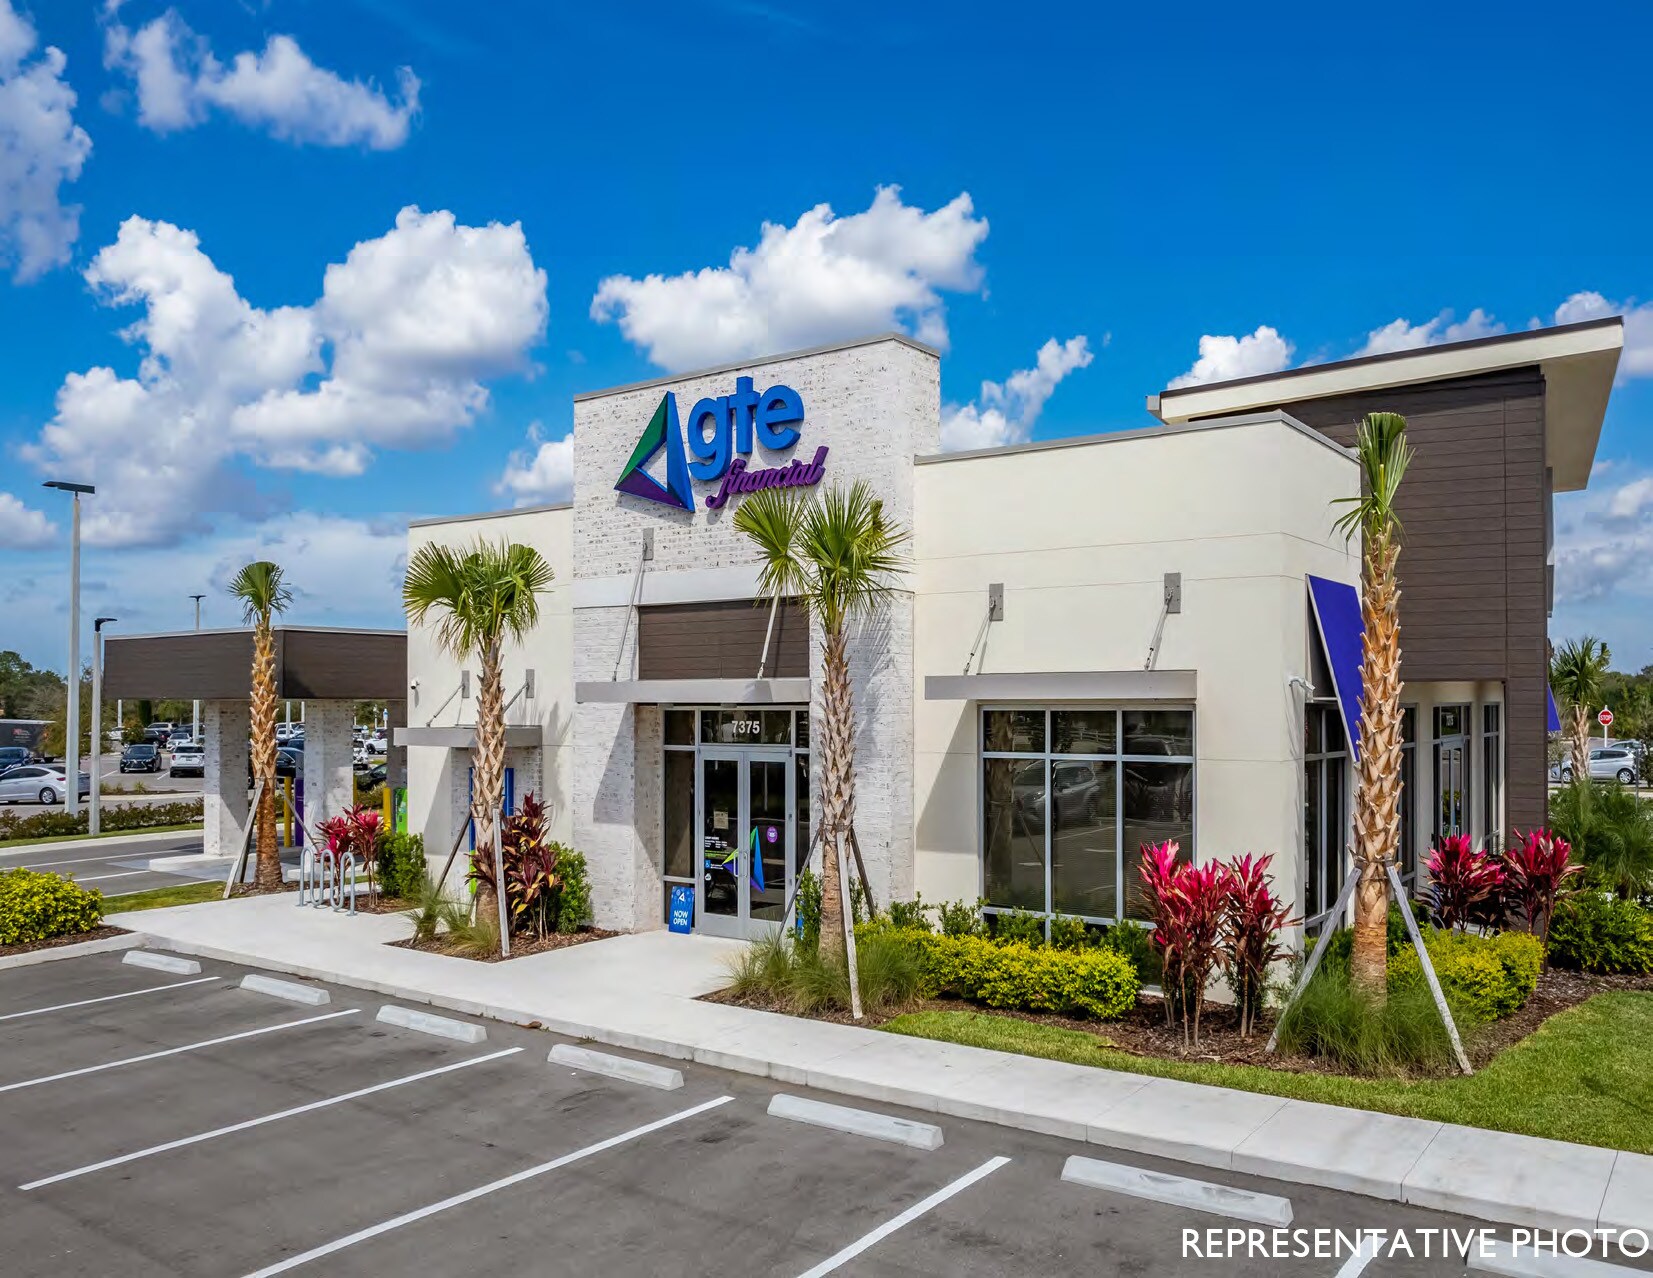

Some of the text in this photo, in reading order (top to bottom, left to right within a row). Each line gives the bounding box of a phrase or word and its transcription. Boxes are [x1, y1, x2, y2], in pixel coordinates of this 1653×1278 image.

[687, 376, 804, 481] gte
[705, 445, 829, 509] financial
[731, 720, 760, 734] 7375
[673, 910, 688, 918] NOW
[672, 918, 688, 926] OPEN
